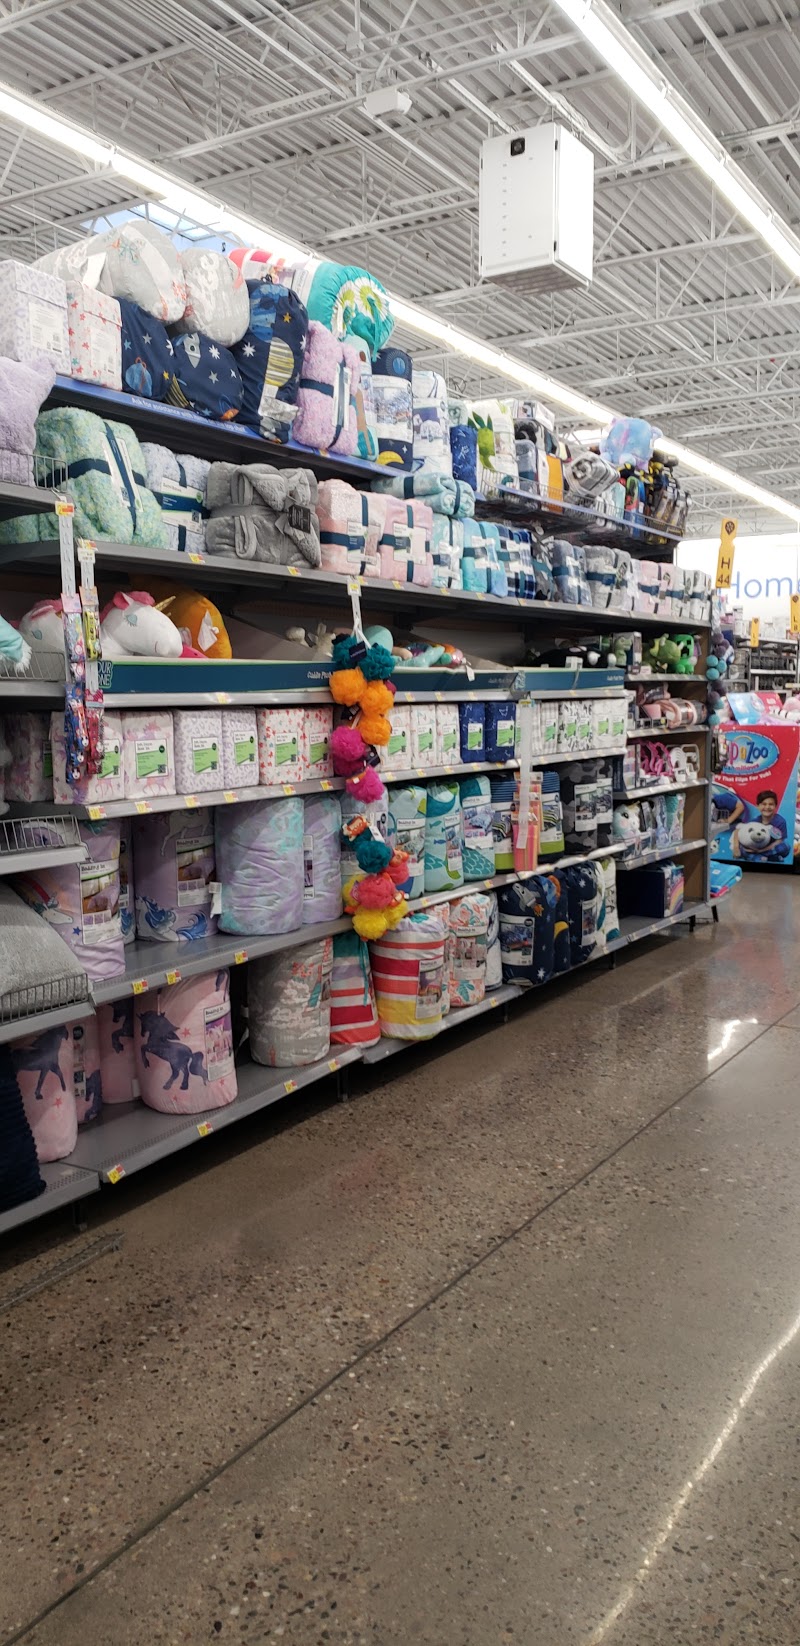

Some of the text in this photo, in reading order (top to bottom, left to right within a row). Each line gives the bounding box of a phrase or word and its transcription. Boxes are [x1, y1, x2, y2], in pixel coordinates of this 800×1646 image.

[721, 557, 731, 570] H
[717, 574, 730, 585] 44
[719, 571, 800, 599] Hom
